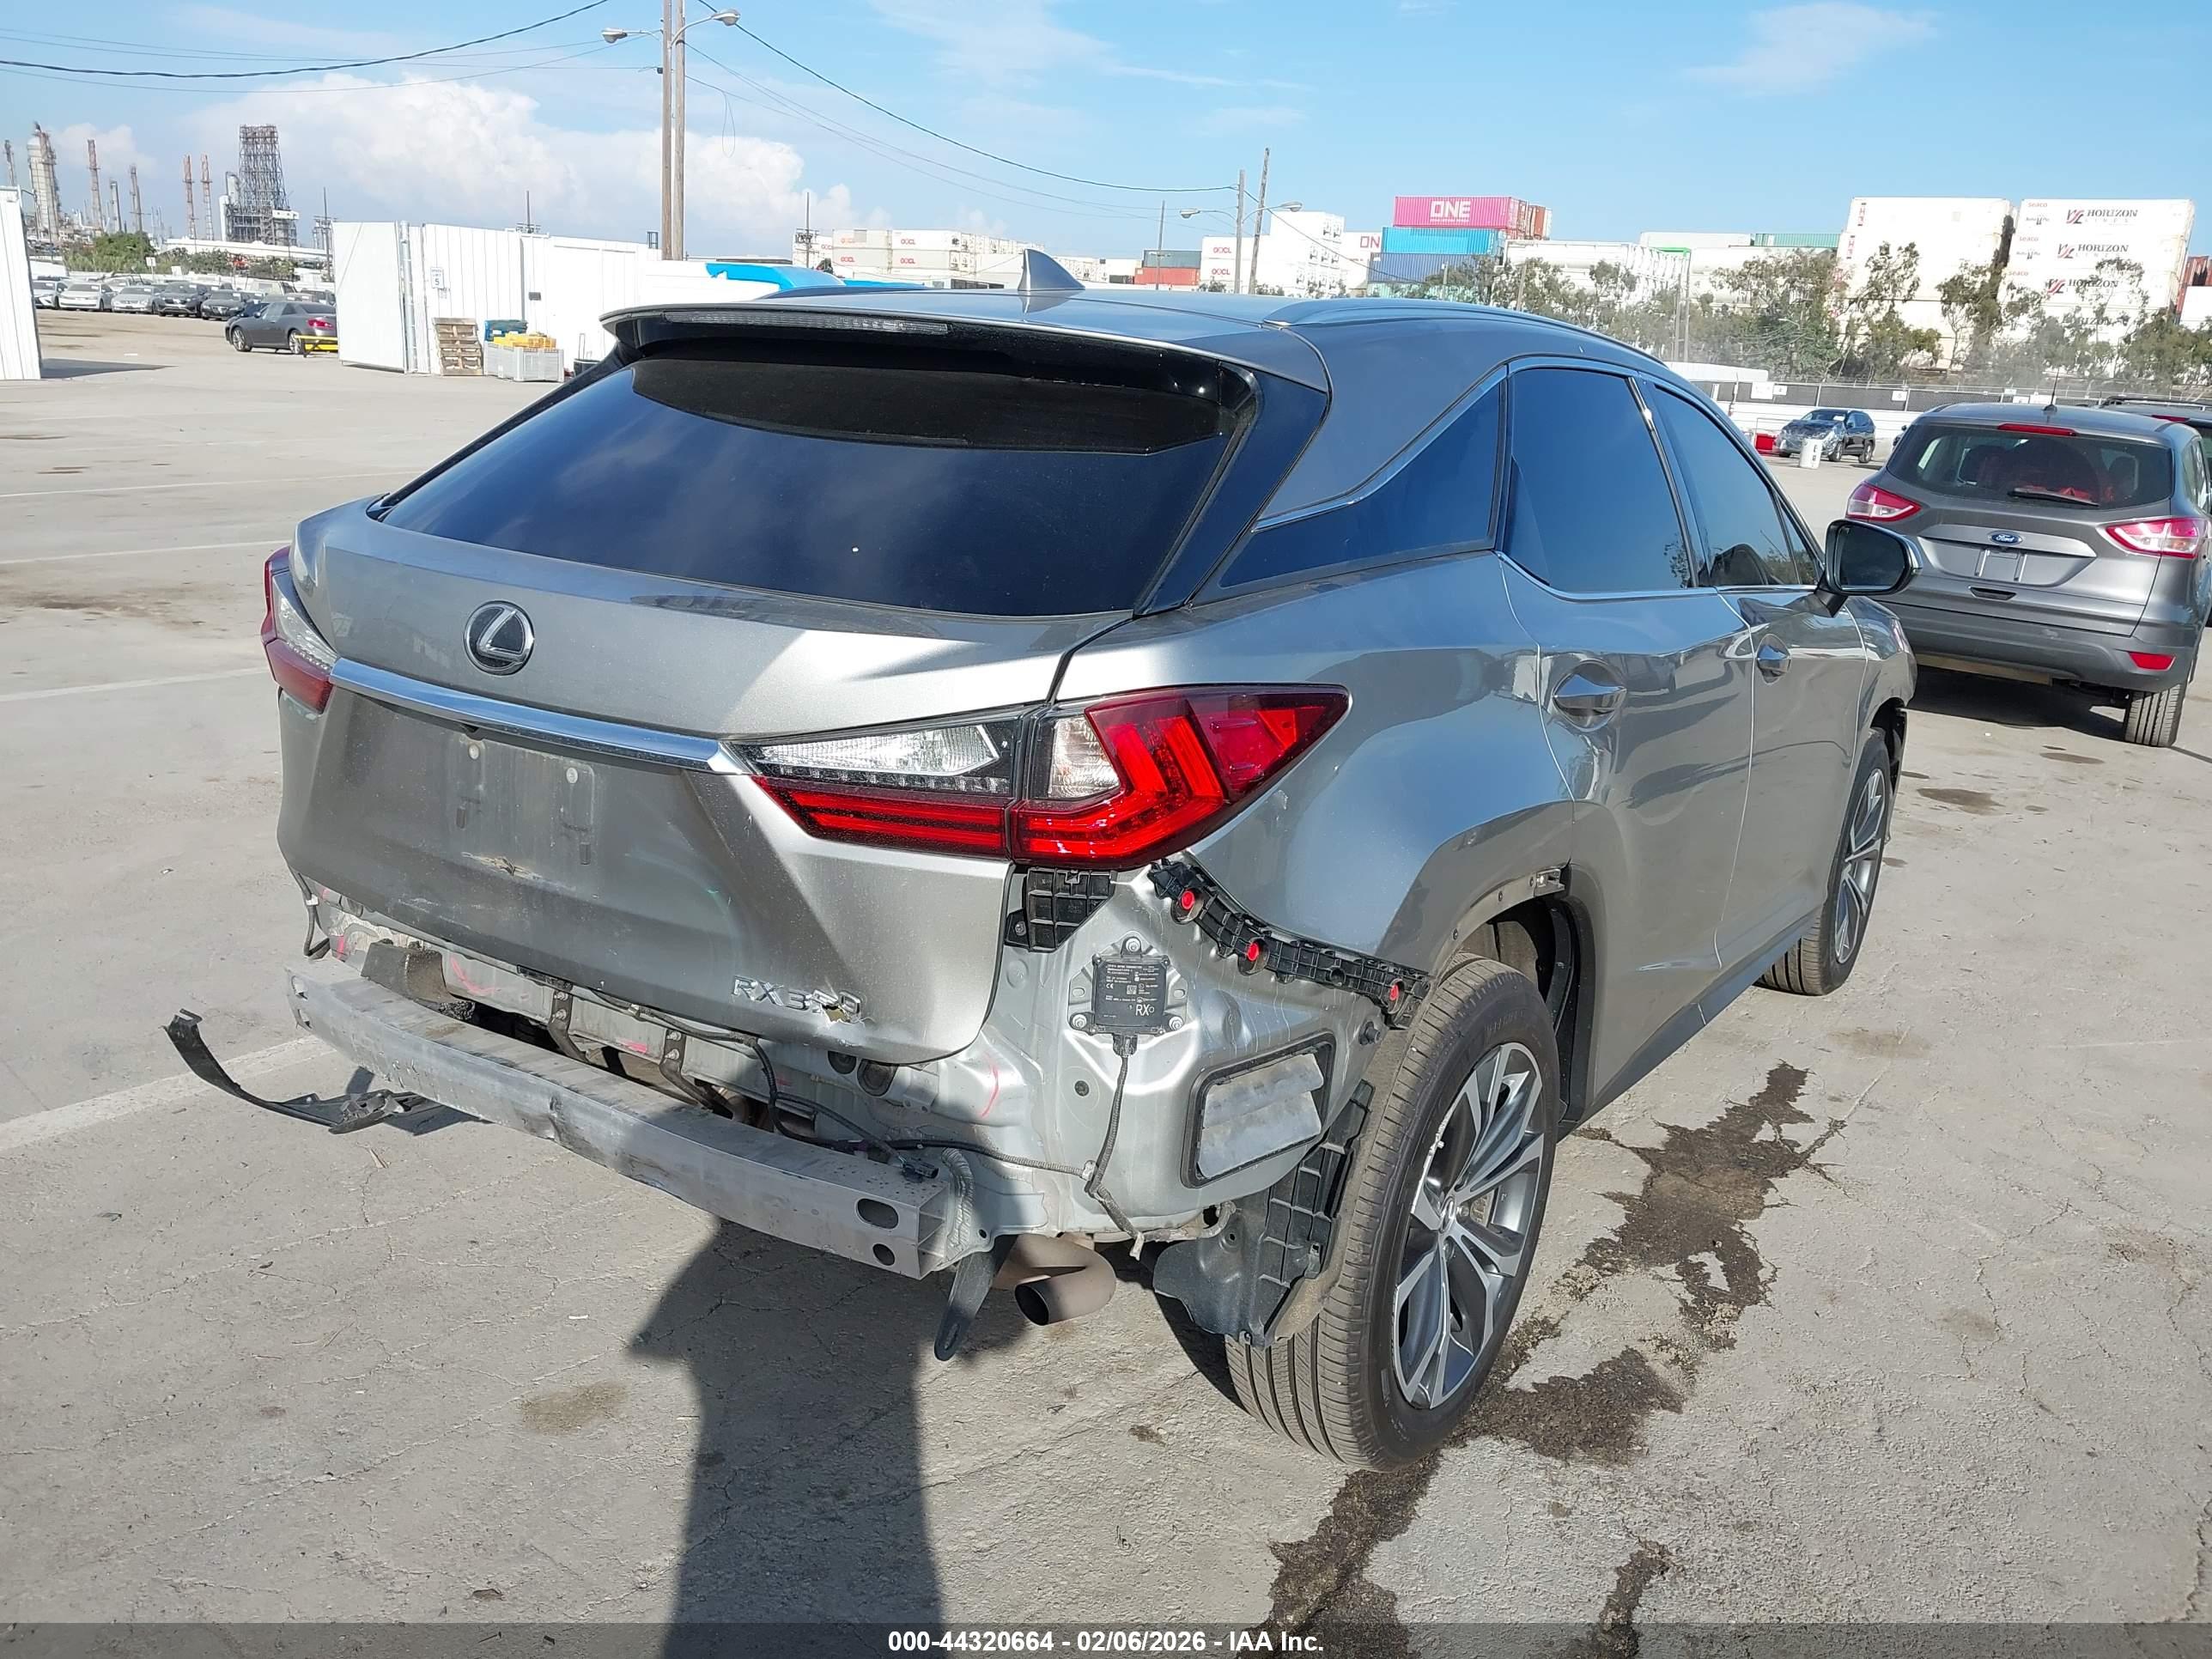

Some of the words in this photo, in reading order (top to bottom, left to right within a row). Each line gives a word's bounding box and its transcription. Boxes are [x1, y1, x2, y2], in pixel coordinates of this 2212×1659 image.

[1430, 200, 1470, 218] ONE
[2087, 209, 2138, 217] HORIZON
[1360, 235, 1380, 248] ON
[2078, 244, 2129, 252] HORIZON
[1996, 534, 2015, 543] Ford
